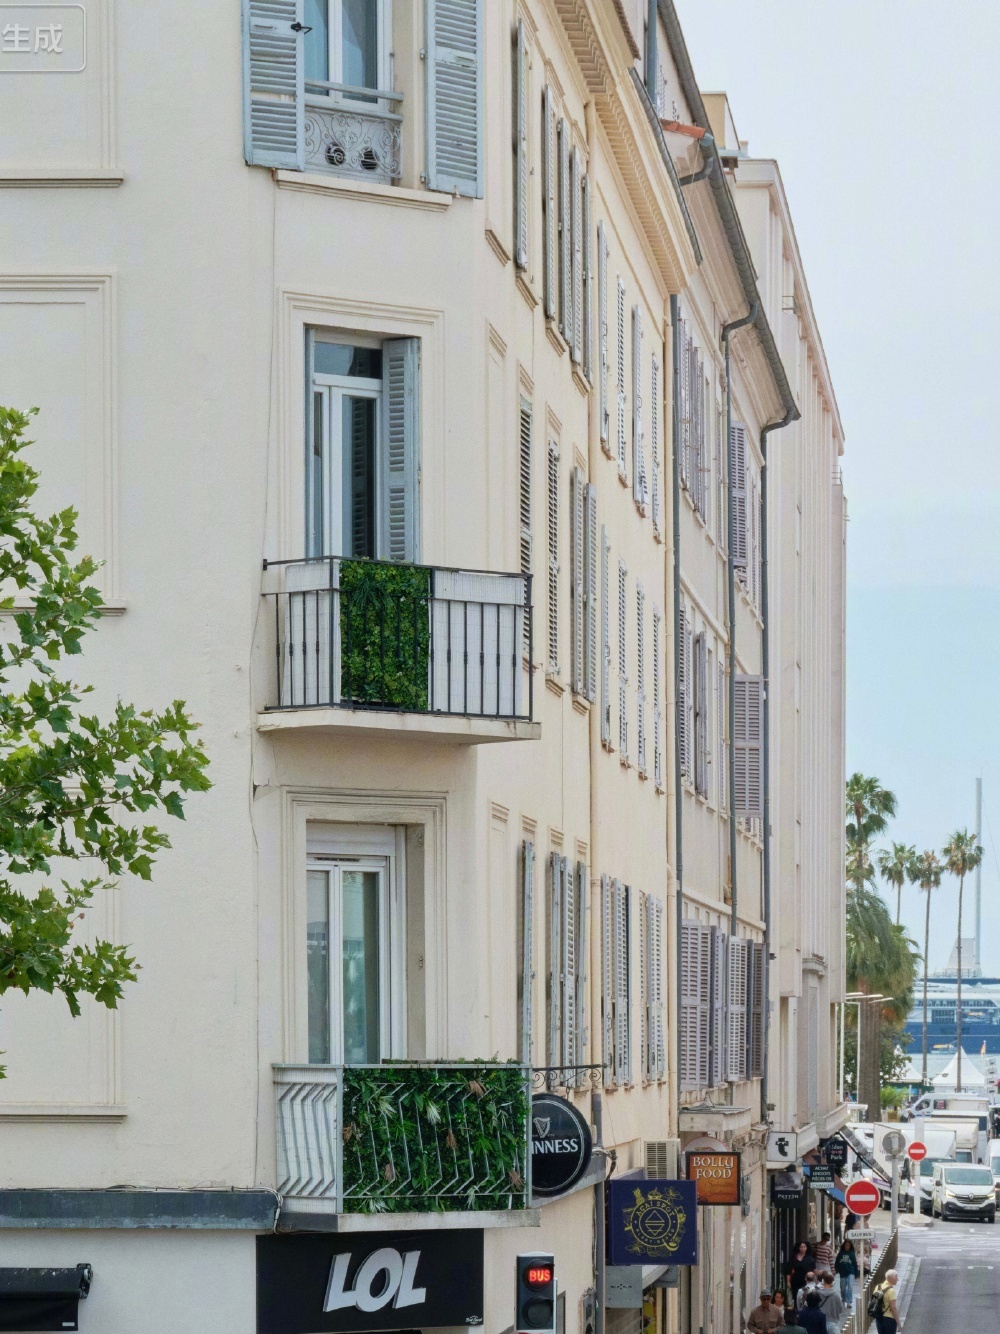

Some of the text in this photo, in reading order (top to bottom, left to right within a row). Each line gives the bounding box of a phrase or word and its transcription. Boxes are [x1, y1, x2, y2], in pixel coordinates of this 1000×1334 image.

[532, 1138, 579, 1154] INNESS
[693, 1156, 734, 1169] BOLLY
[696, 1168, 732, 1179] FOOD
[323, 1247, 426, 1313] LOL
[529, 1269, 551, 1283] BUS
